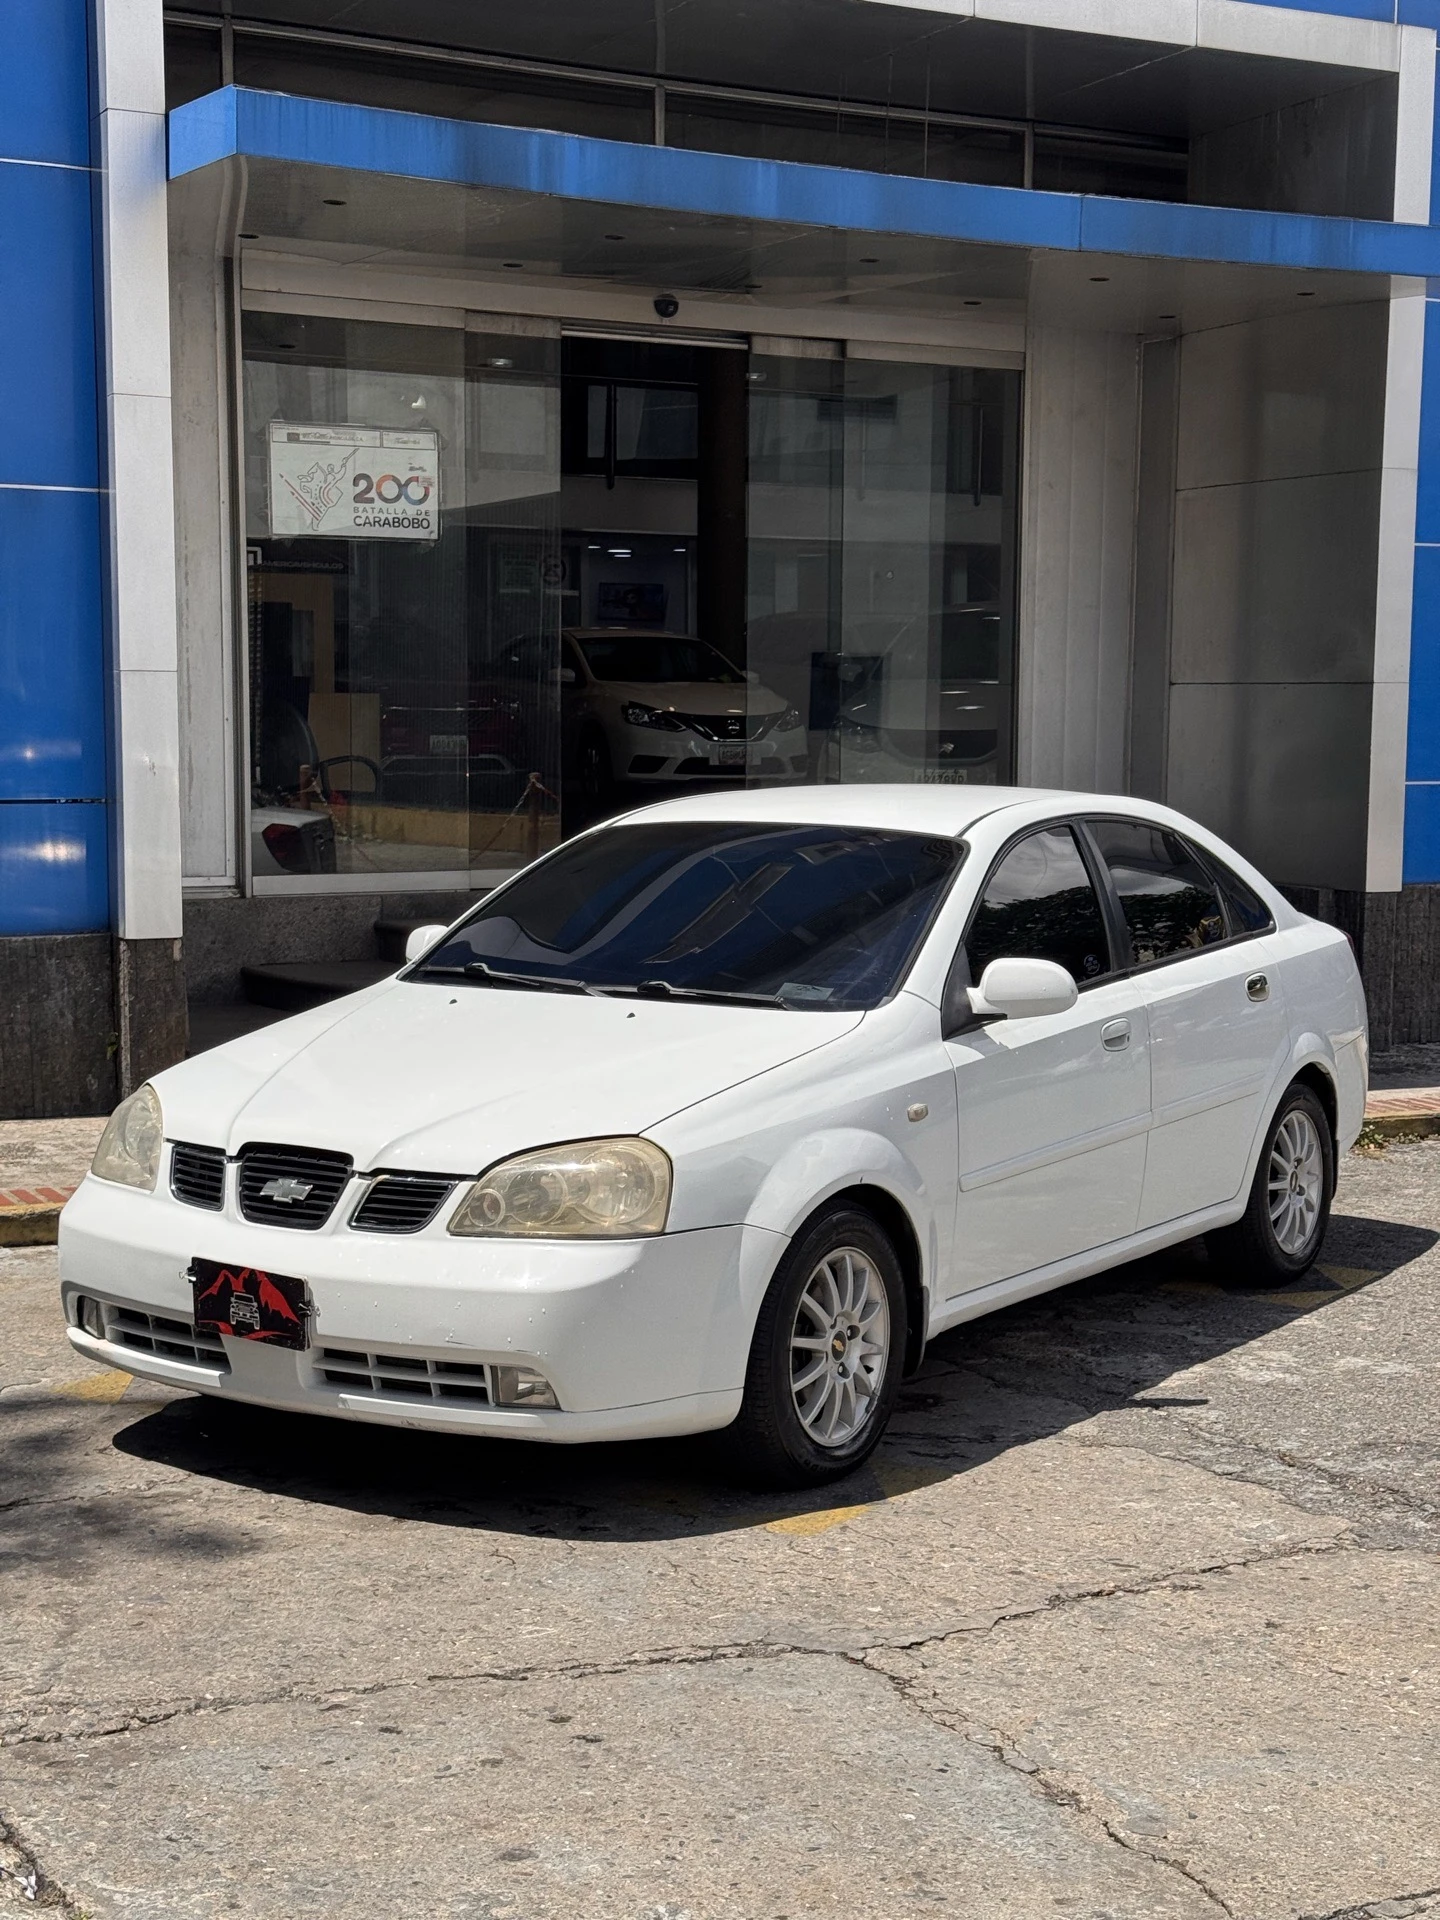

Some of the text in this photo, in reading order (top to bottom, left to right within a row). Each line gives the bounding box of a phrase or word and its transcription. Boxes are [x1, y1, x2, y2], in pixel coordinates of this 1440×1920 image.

[353, 473, 430, 506] 200
[353, 506, 431, 517] BATALLA DE
[353, 515, 431, 530] CARABOBO
